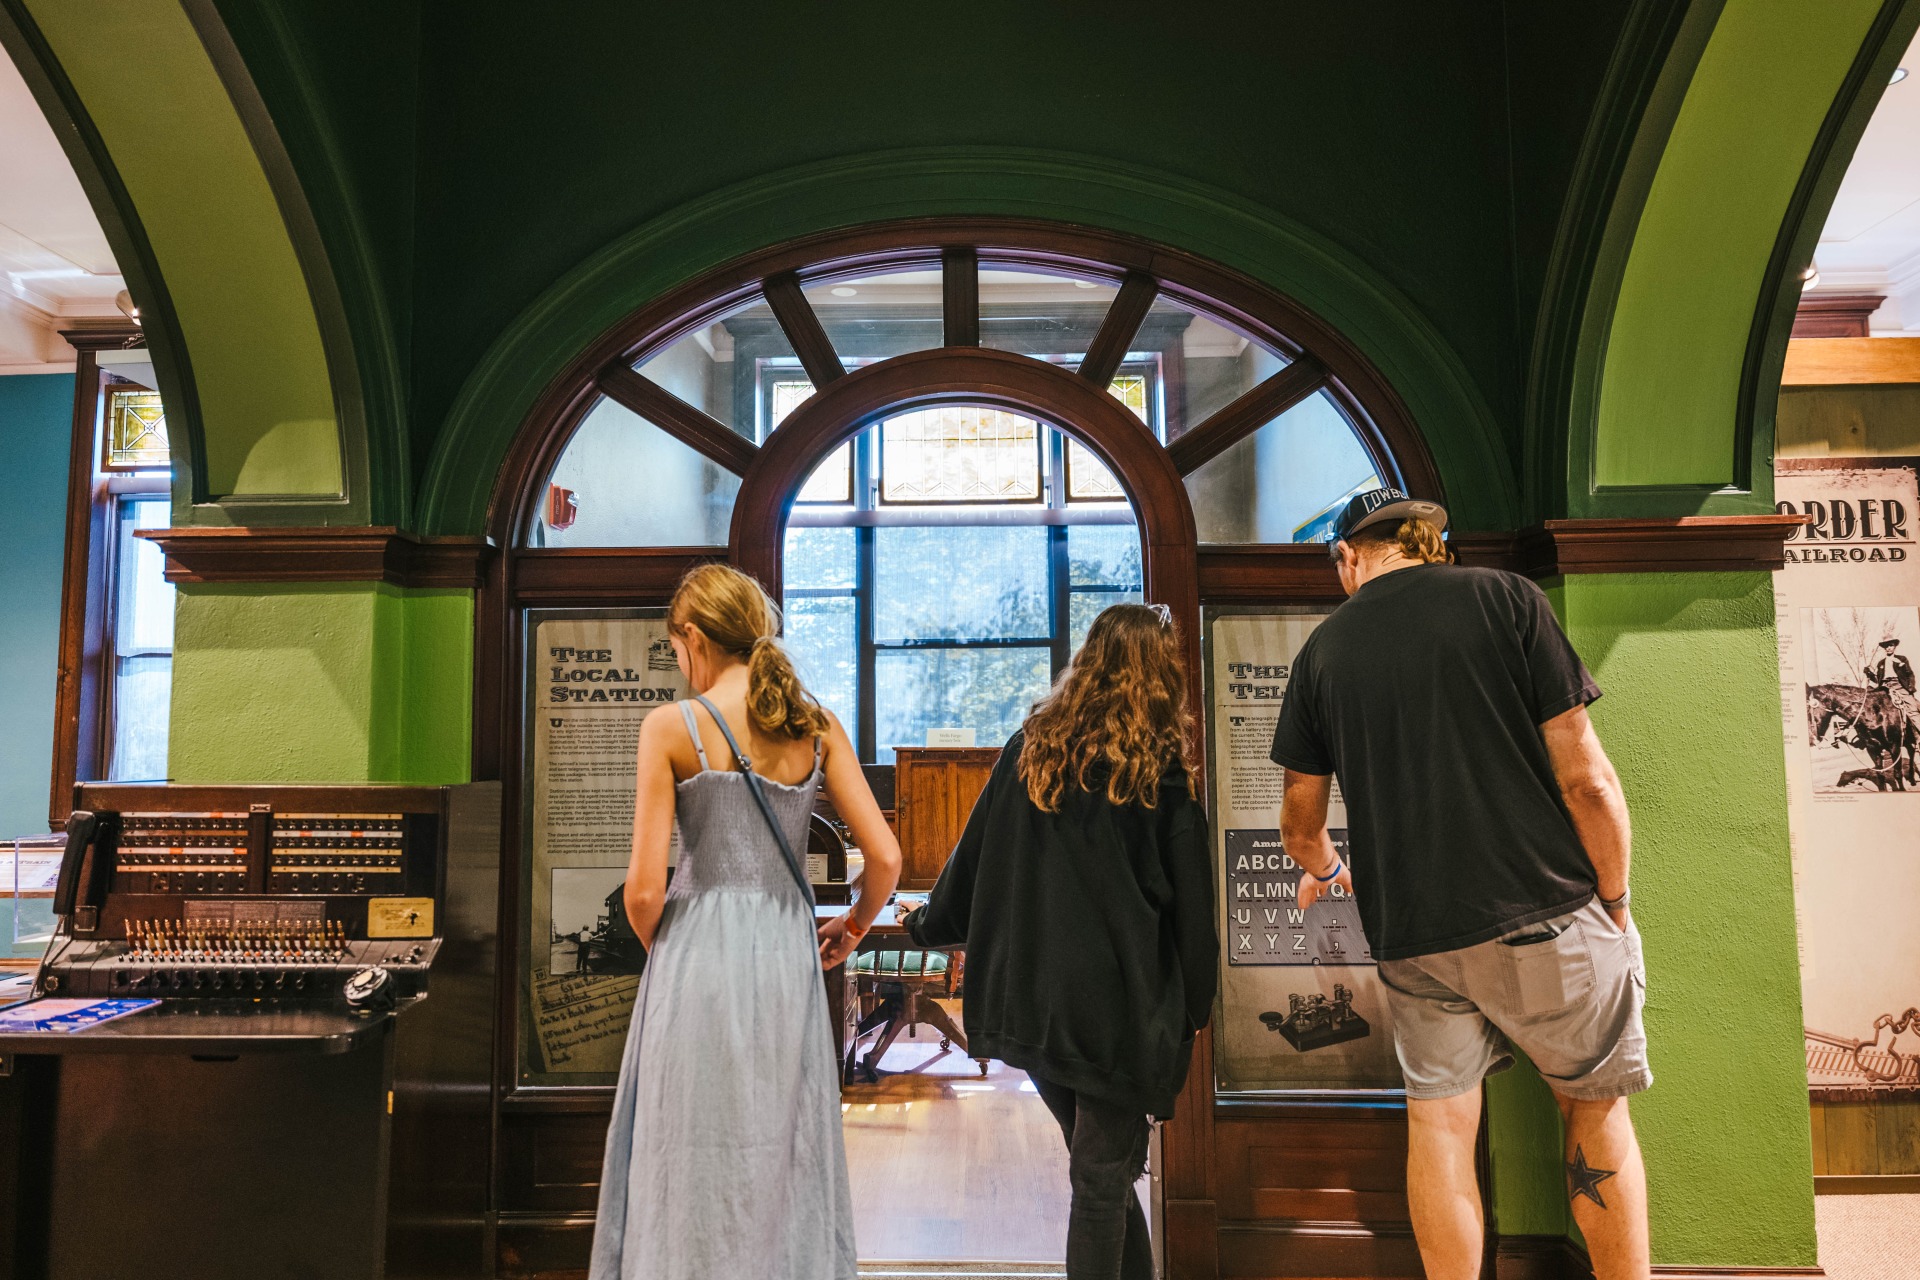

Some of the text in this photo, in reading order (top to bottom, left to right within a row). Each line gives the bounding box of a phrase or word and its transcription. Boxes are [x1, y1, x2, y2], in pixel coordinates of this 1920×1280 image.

[550, 647, 612, 662] THE
[551, 666, 639, 682] LOCAL
[1229, 663, 1289, 679] THE
[550, 686, 676, 702] STATION
